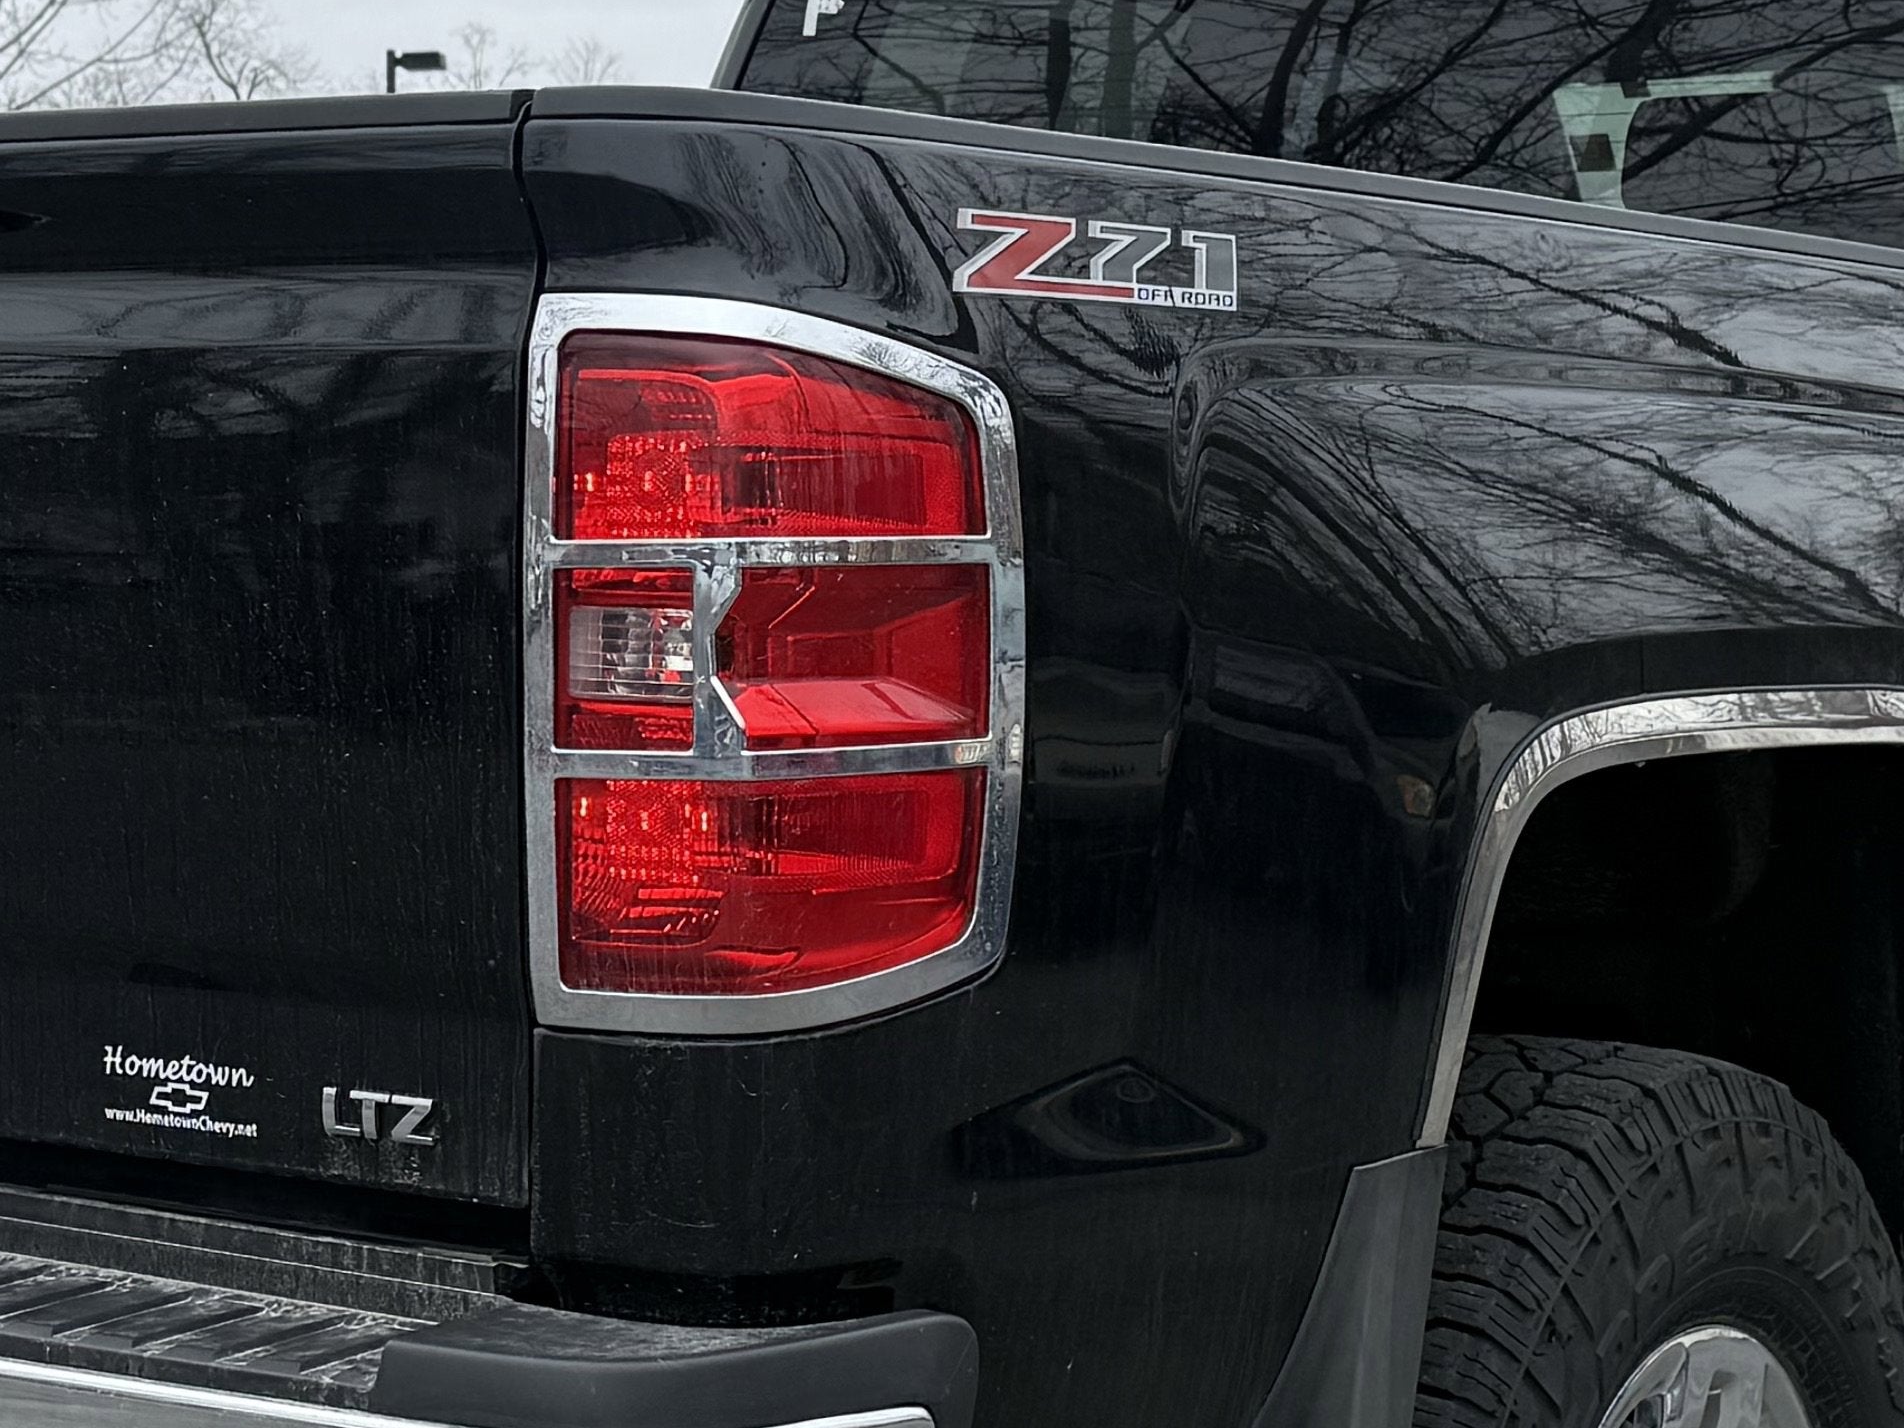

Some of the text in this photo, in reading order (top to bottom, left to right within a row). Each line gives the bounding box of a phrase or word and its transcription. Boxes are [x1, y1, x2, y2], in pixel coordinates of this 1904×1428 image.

[952, 208, 1237, 301] Z71
[1181, 291, 1233, 307] ROAD
[103, 1045, 254, 1088] Hometown
[322, 1086, 436, 1145] LTZ
